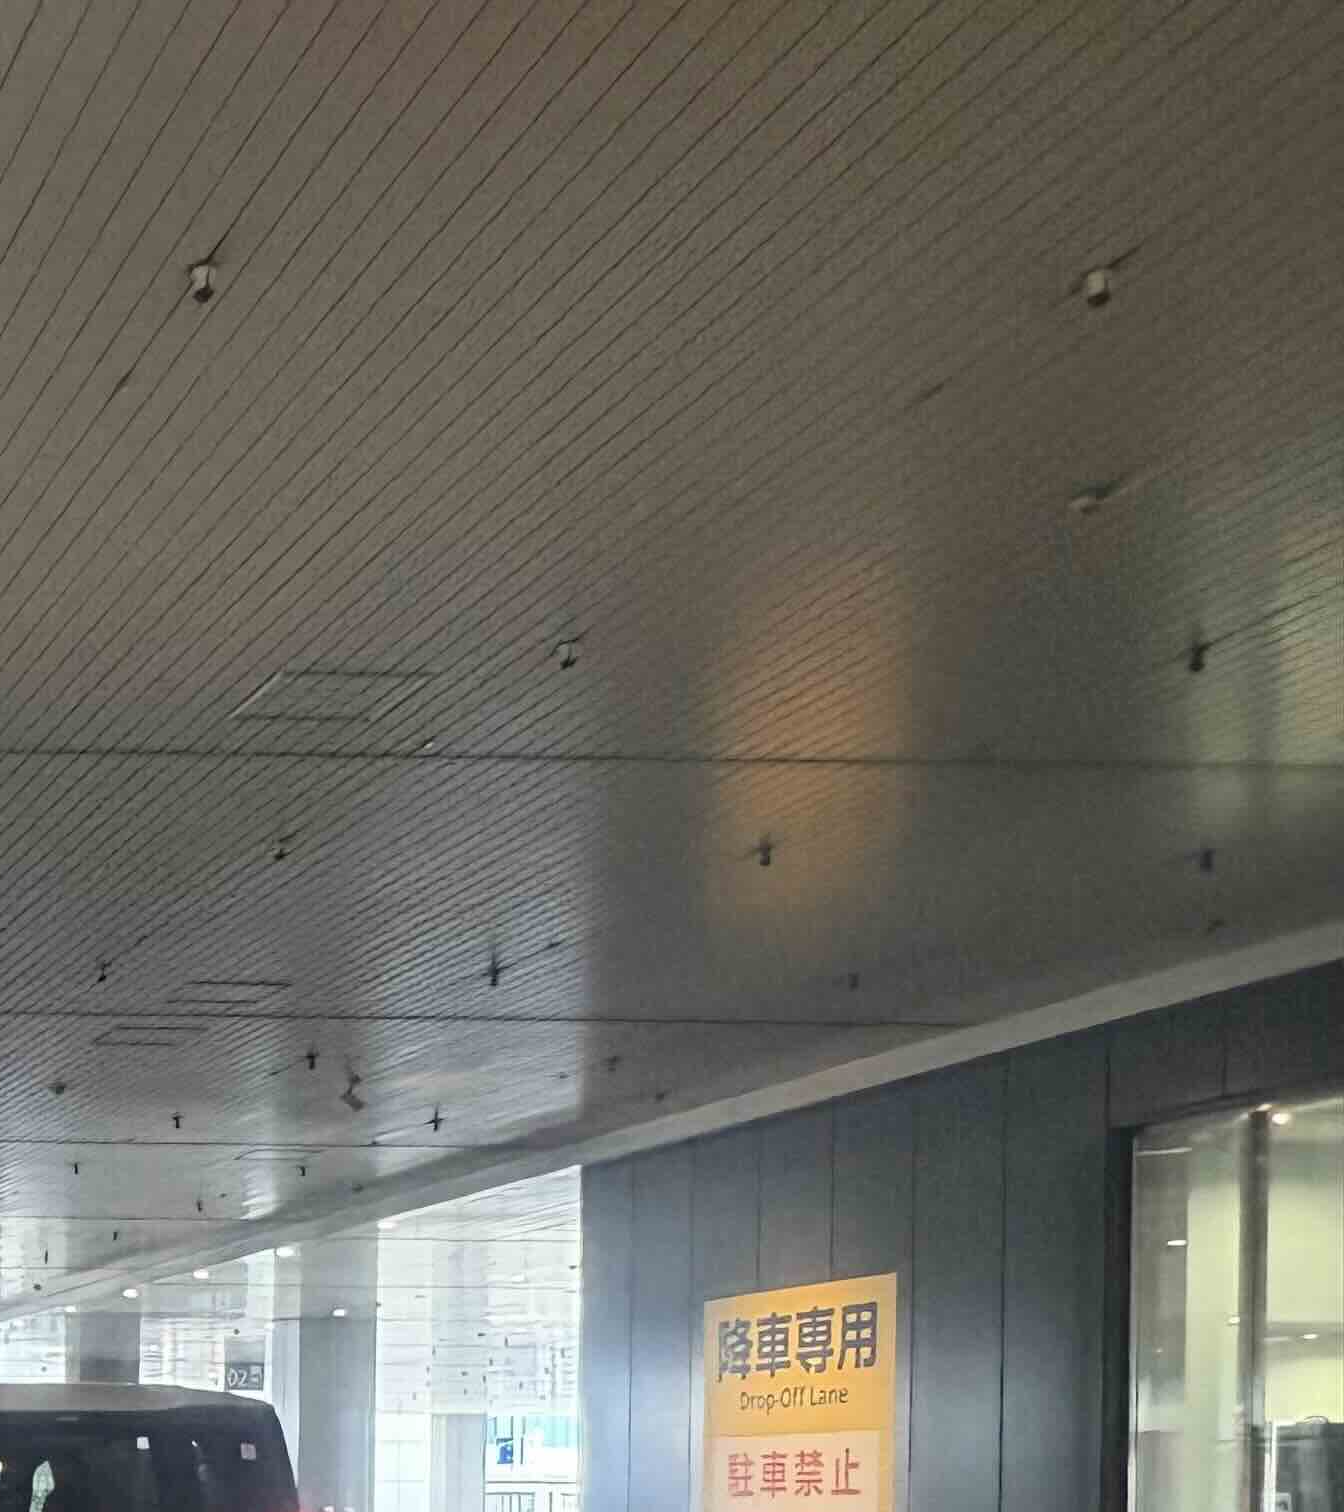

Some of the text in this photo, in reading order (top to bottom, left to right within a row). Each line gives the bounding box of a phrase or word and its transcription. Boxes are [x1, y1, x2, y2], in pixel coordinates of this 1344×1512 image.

[717, 1302, 879, 1384] 降車専用
[740, 1386, 849, 1415] Drop-Off Lane
[727, 1448, 861, 1499] 駐車禁止
